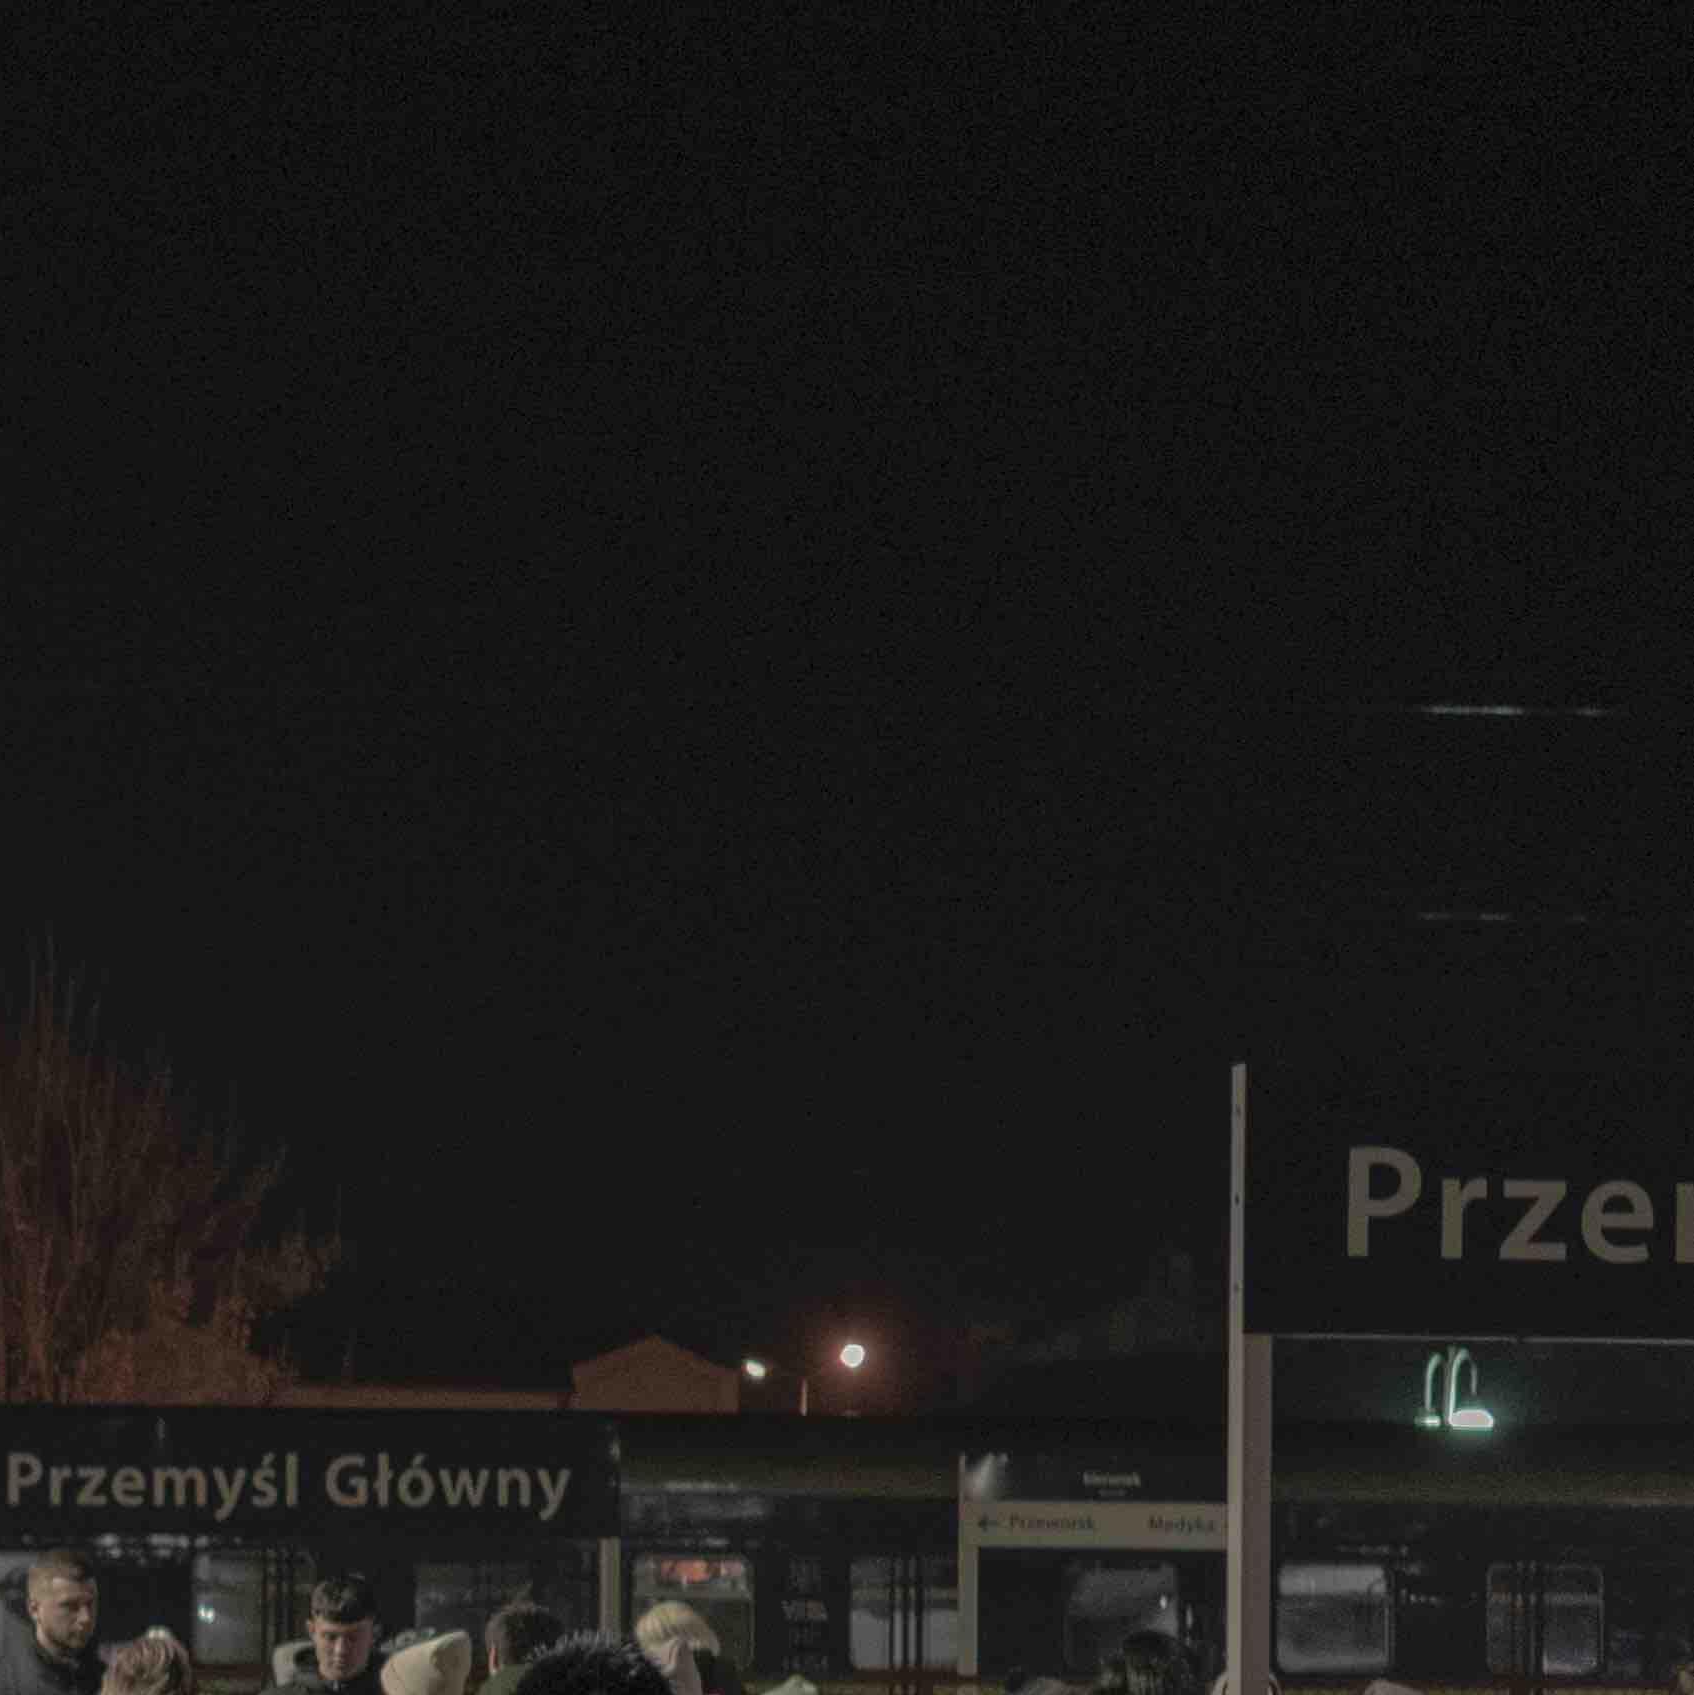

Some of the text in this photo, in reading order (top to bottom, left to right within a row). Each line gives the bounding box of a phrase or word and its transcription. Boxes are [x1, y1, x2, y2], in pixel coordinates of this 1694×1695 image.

[1346, 1145, 1694, 1264] Prze
[5, 1450, 573, 1522] Przemyśl Główny
